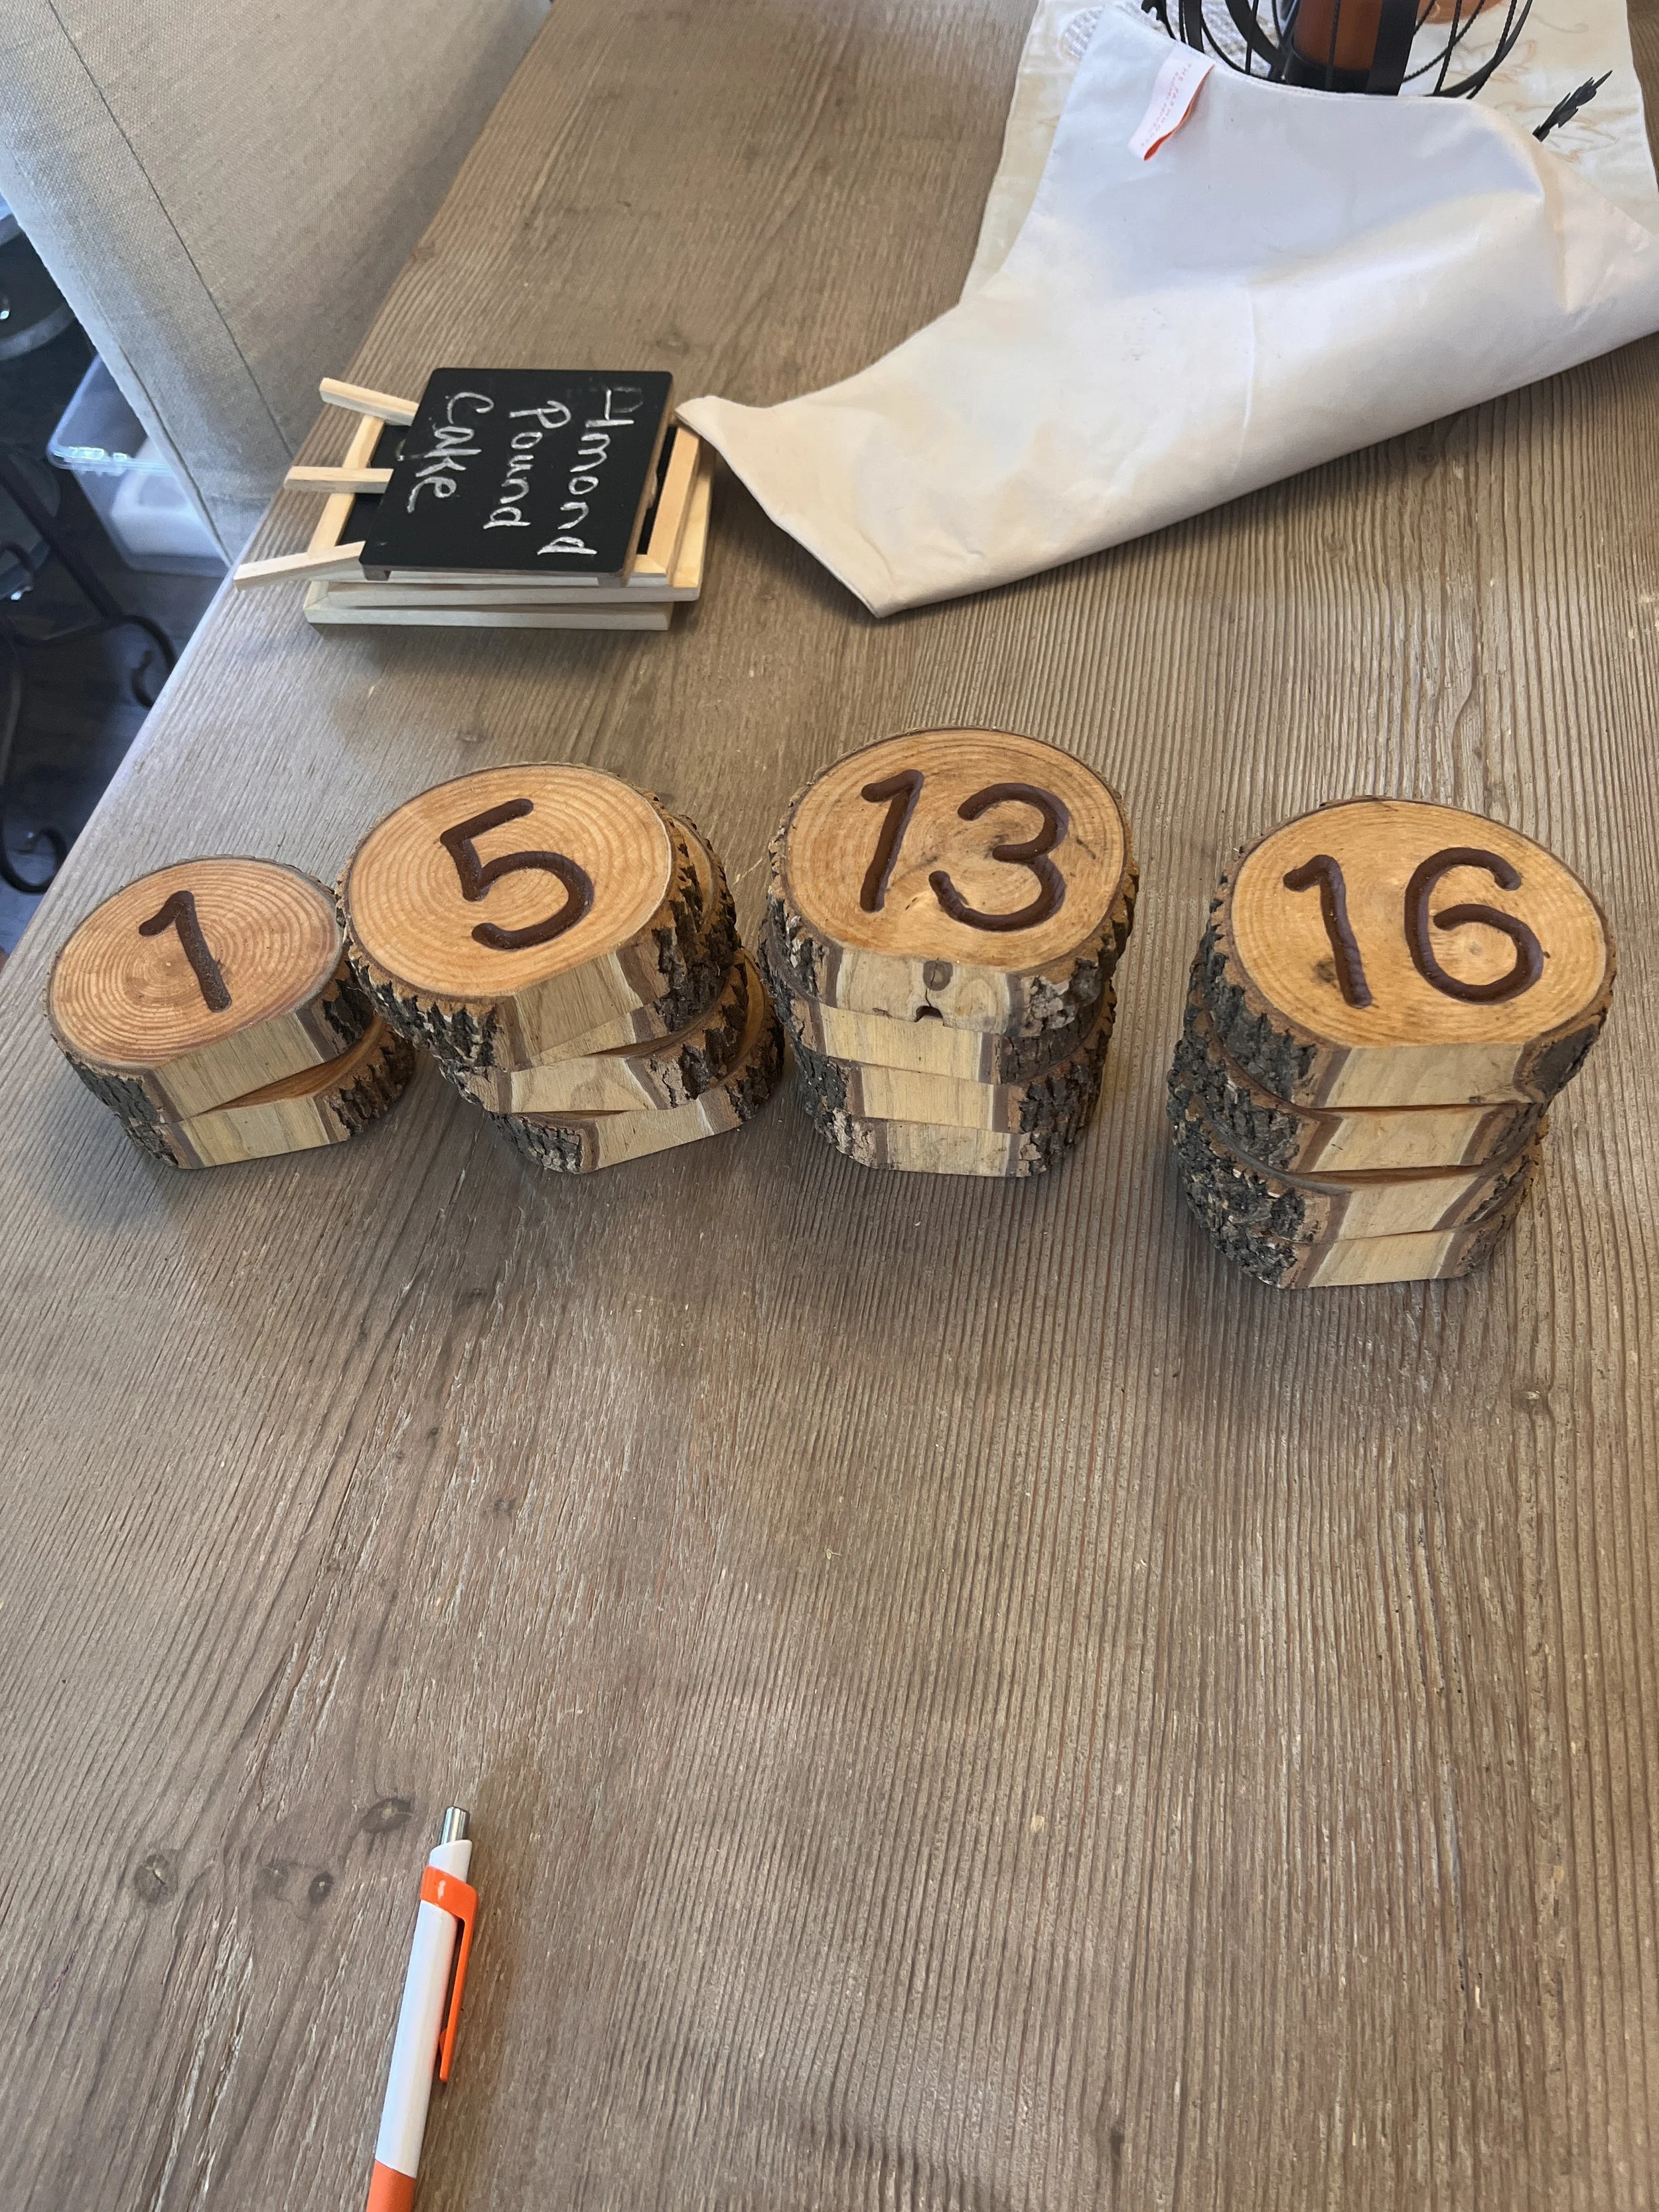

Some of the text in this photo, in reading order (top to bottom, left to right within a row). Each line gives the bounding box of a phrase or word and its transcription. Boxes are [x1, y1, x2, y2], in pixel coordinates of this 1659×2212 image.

[406, 392, 494, 514] Cake
[482, 400, 572, 529] Pound
[439, 798, 595, 951] 5
[859, 769, 1071, 932] 13
[138, 890, 232, 1013] 1
[1283, 847, 1544, 1009] 16
